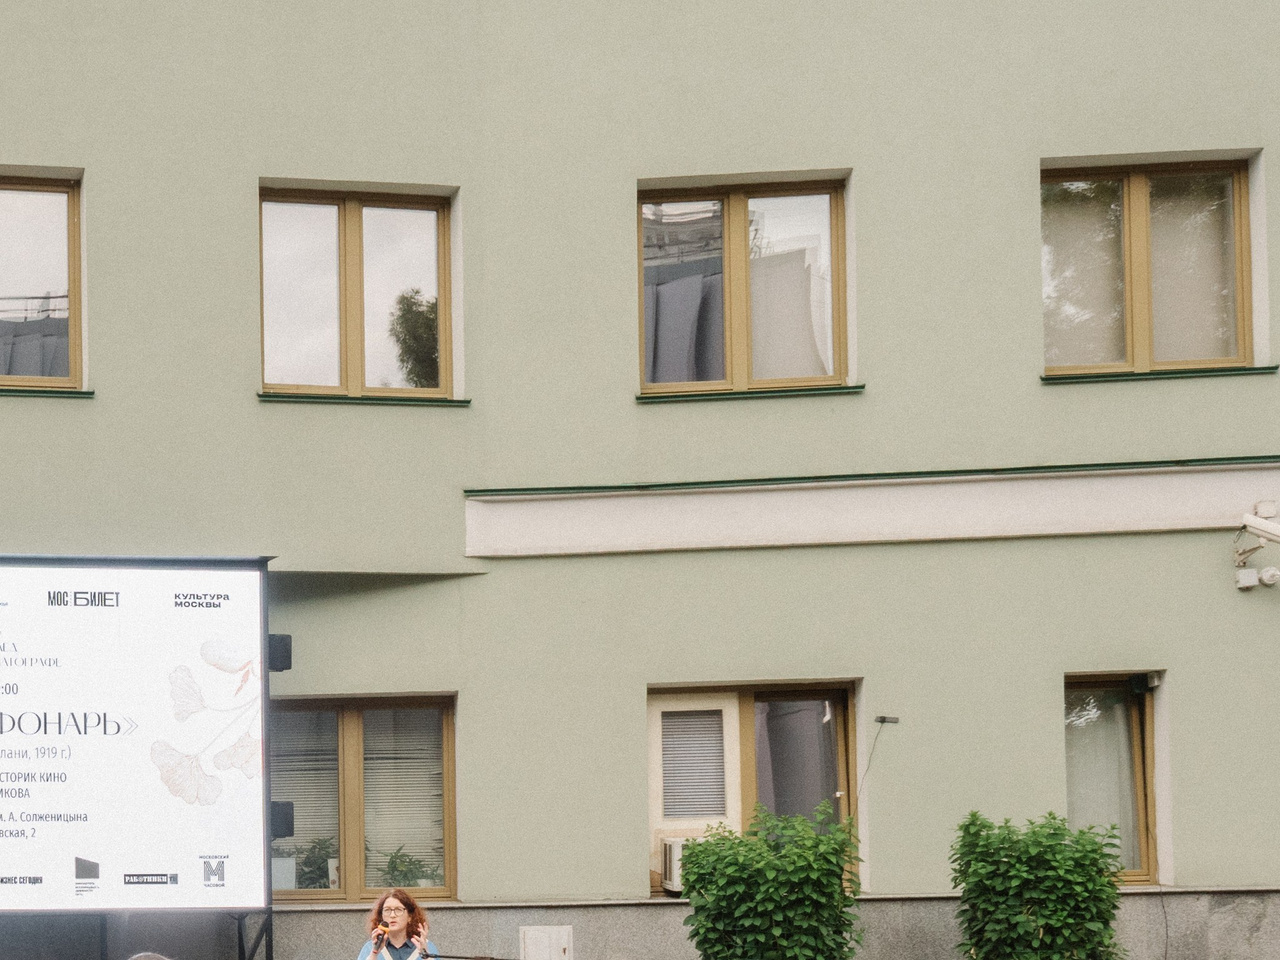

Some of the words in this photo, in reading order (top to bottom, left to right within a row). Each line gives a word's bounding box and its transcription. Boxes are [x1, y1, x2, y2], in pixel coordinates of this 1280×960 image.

[48, 591, 68, 607] МОС
[74, 591, 120, 607] БИЛЕТ
[35, 747, 57, 759] 1919
[61, 745, 72, 760] г.)
[39, 772, 67, 783] КИНО
[8, 812, 17, 822] А.
[20, 812, 88, 824] Солженицына
[30, 828, 36, 838] 2
